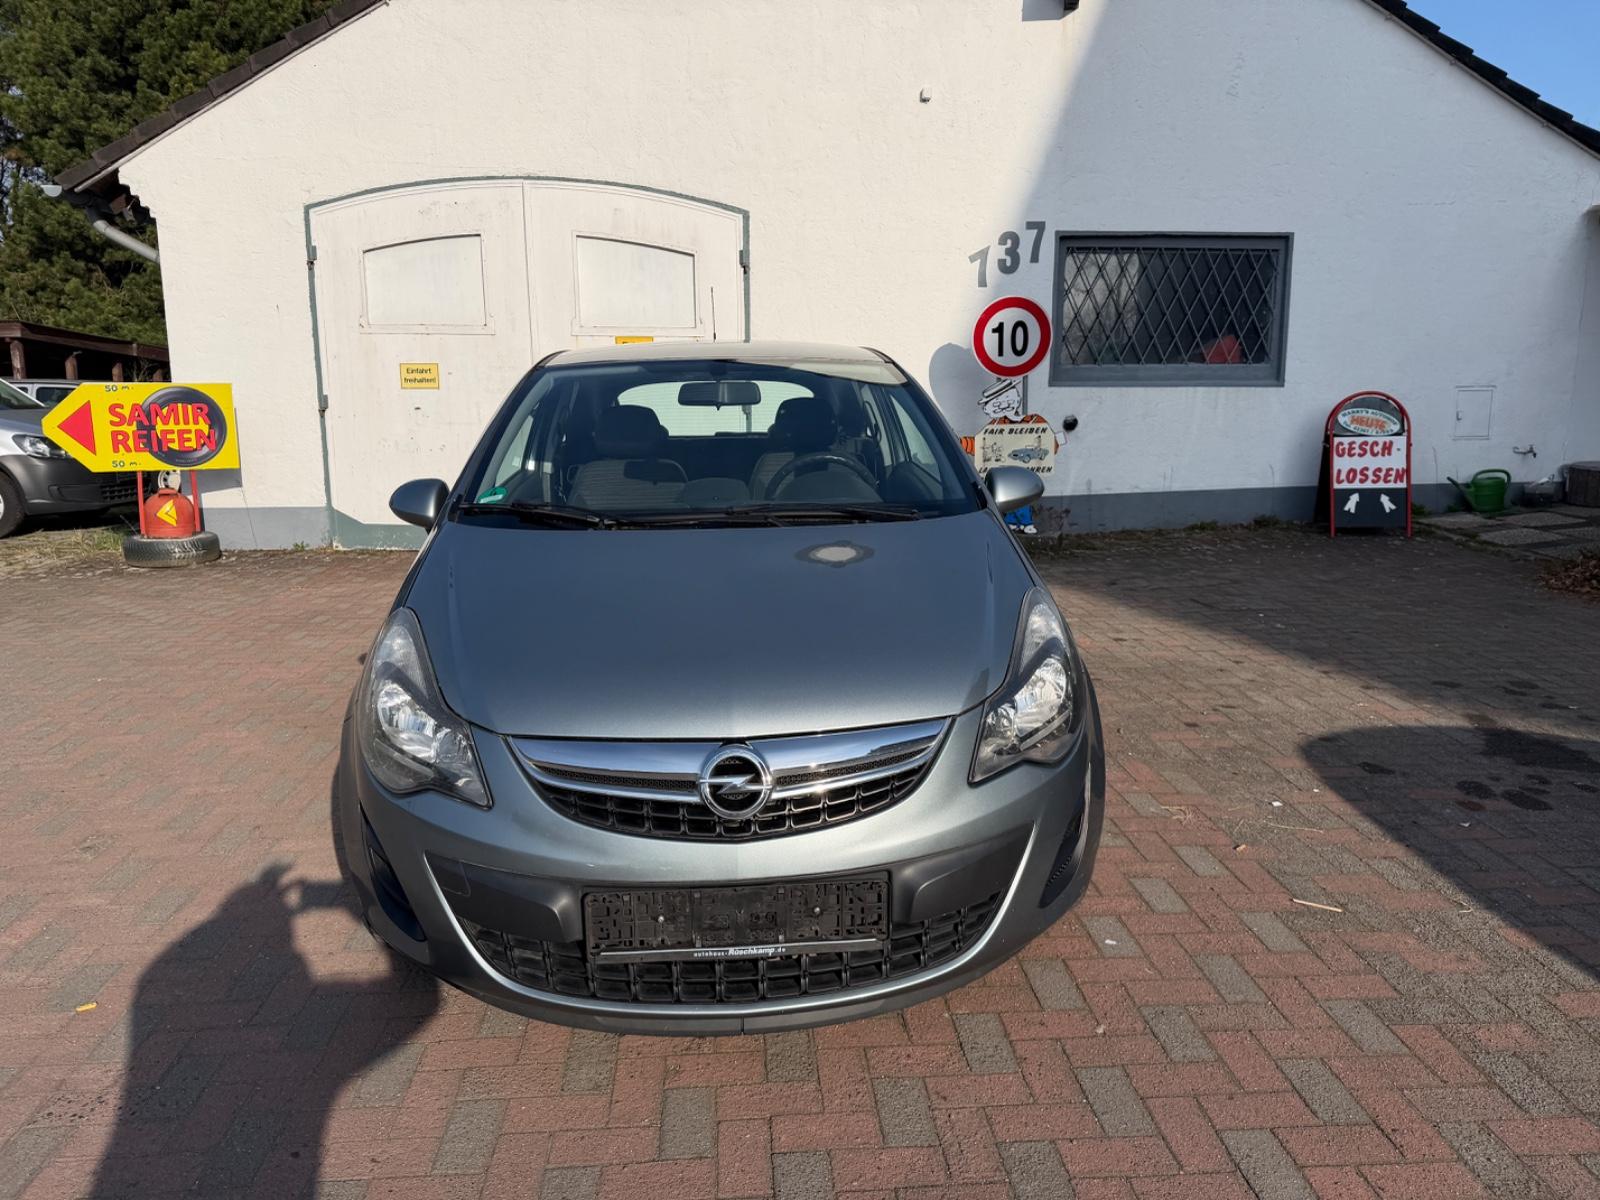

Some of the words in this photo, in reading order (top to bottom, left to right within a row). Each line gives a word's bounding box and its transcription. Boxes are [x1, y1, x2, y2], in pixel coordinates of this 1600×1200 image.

[968, 221, 1046, 288] 737
[991, 320, 1029, 357] 10
[105, 384, 118, 392] 50
[108, 402, 211, 427] SAMIR
[111, 429, 217, 454] REIFEN
[1008, 427, 1048, 435] BLEIBEN
[112, 460, 125, 468] 50
[1335, 466, 1407, 485] LOSSEN
